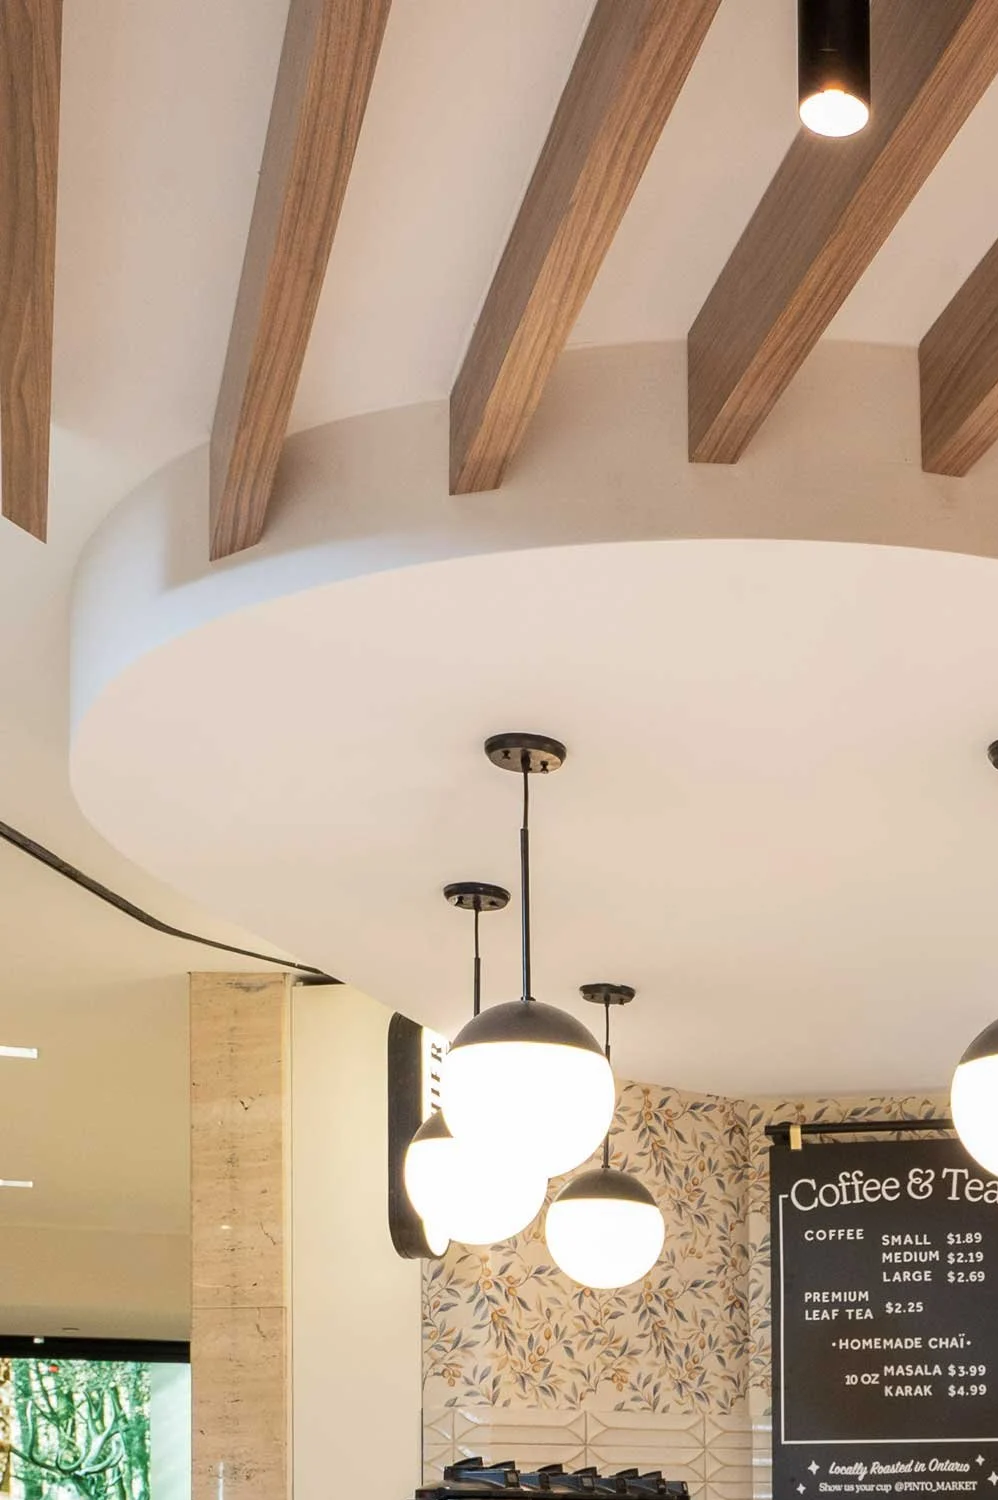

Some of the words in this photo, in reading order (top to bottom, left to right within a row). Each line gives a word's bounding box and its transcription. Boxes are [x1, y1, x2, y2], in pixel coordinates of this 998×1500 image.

[790, 1170, 900, 1211] Coffee
[907, 1168, 935, 1200] &
[804, 1229, 865, 1241] COFFEE
[882, 1234, 931, 1246] SMALL
[947, 1232, 982, 1245] $1.89
[882, 1250, 940, 1264] MEDIUM
[947, 1252, 984, 1264] $2.19
[882, 1271, 932, 1283] LARGE
[947, 1271, 985, 1283] $2.69
[804, 1291, 869, 1303] PREMIUM
[805, 1309, 839, 1321] LEAF
[846, 1309, 874, 1320] TEA
[885, 1302, 924, 1314] $2.25
[845, 1374, 858, 1385] 10
[861, 1374, 879, 1385] OZ
[884, 1365, 942, 1377] MASALA
[948, 1365, 986, 1377] $3.99
[884, 1385, 932, 1397] KARAK
[948, 1385, 987, 1397] $4.99
[829, 1462, 867, 1481] Locally
[870, 1460, 914, 1475] Roasted
[915, 1461, 926, 1473] in
[928, 1458, 970, 1473] Ontario
[819, 1483, 842, 1492] Show
[844, 1484, 855, 1492] us
[855, 1484, 876, 1494] your
[877, 1484, 892, 1494] cup
[894, 1481, 978, 1493] @PINTO_MARKET
